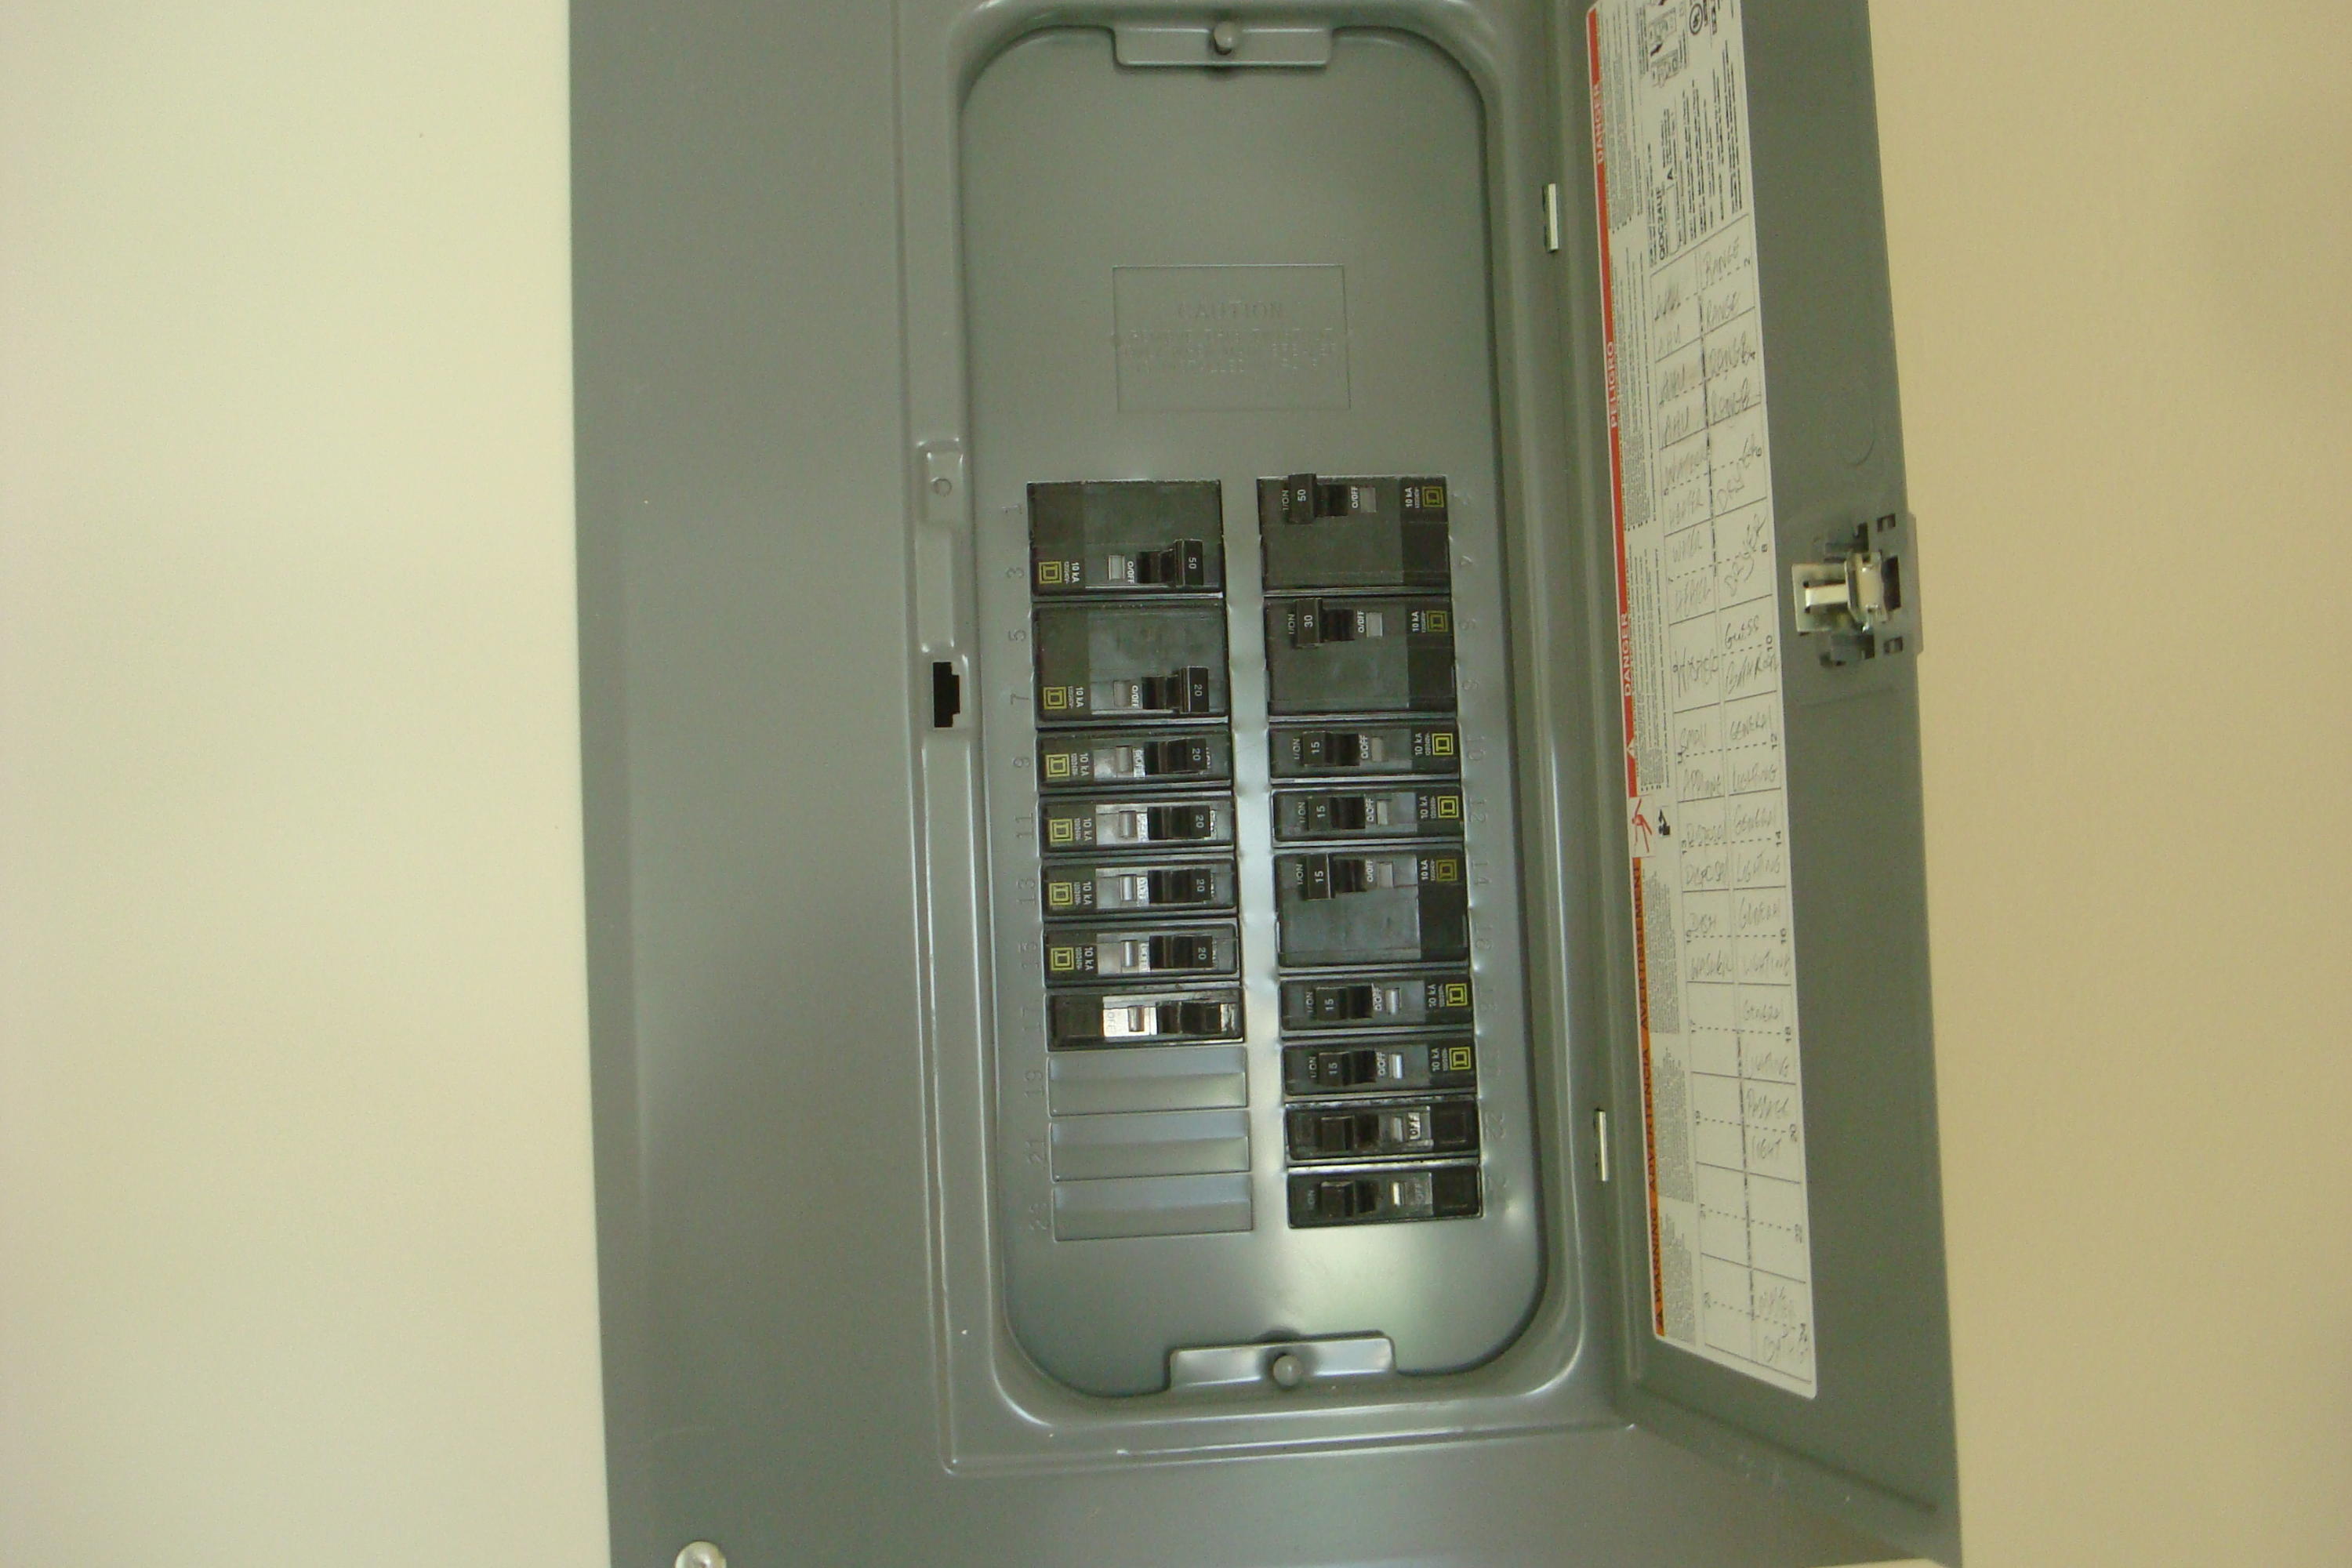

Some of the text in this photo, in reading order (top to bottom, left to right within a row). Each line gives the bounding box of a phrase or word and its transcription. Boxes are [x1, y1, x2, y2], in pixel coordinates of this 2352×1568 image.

[1592, 84, 1604, 165] DANGER
[1606, 342, 1617, 428] PELIGRO
[1298, 489, 1306, 502] 50
[1406, 498, 1413, 508] 10
[1071, 562, 1080, 572] 10
[1189, 557, 1197, 570] 50
[1304, 615, 1313, 628] 30
[1412, 622, 1420, 632] 10
[1007, 629, 1027, 643] 5
[1621, 613, 1632, 697] DANGER
[1076, 687, 1084, 696] 10
[1194, 684, 1203, 697] 20
[1009, 692, 1030, 706] 7
[1311, 741, 1320, 754] 15
[1414, 745, 1423, 756] 10
[1080, 753, 1088, 763] 10
[1192, 748, 1201, 761] 20
[1317, 805, 1326, 818] 15
[1421, 808, 1428, 819] 10
[1083, 818, 1092, 828] 10
[1196, 815, 1204, 829] 20
[1315, 871, 1323, 883] 15
[1421, 871, 1428, 880] 10
[1083, 881, 1092, 891] 10
[1196, 878, 1205, 892] 20
[1084, 947, 1094, 956] 10
[1198, 947, 1207, 960] 20
[1324, 998, 1334, 1011] 15
[1428, 996, 1436, 1007] 10
[1329, 1062, 1338, 1075] 15
[1432, 1060, 1440, 1071] 10
